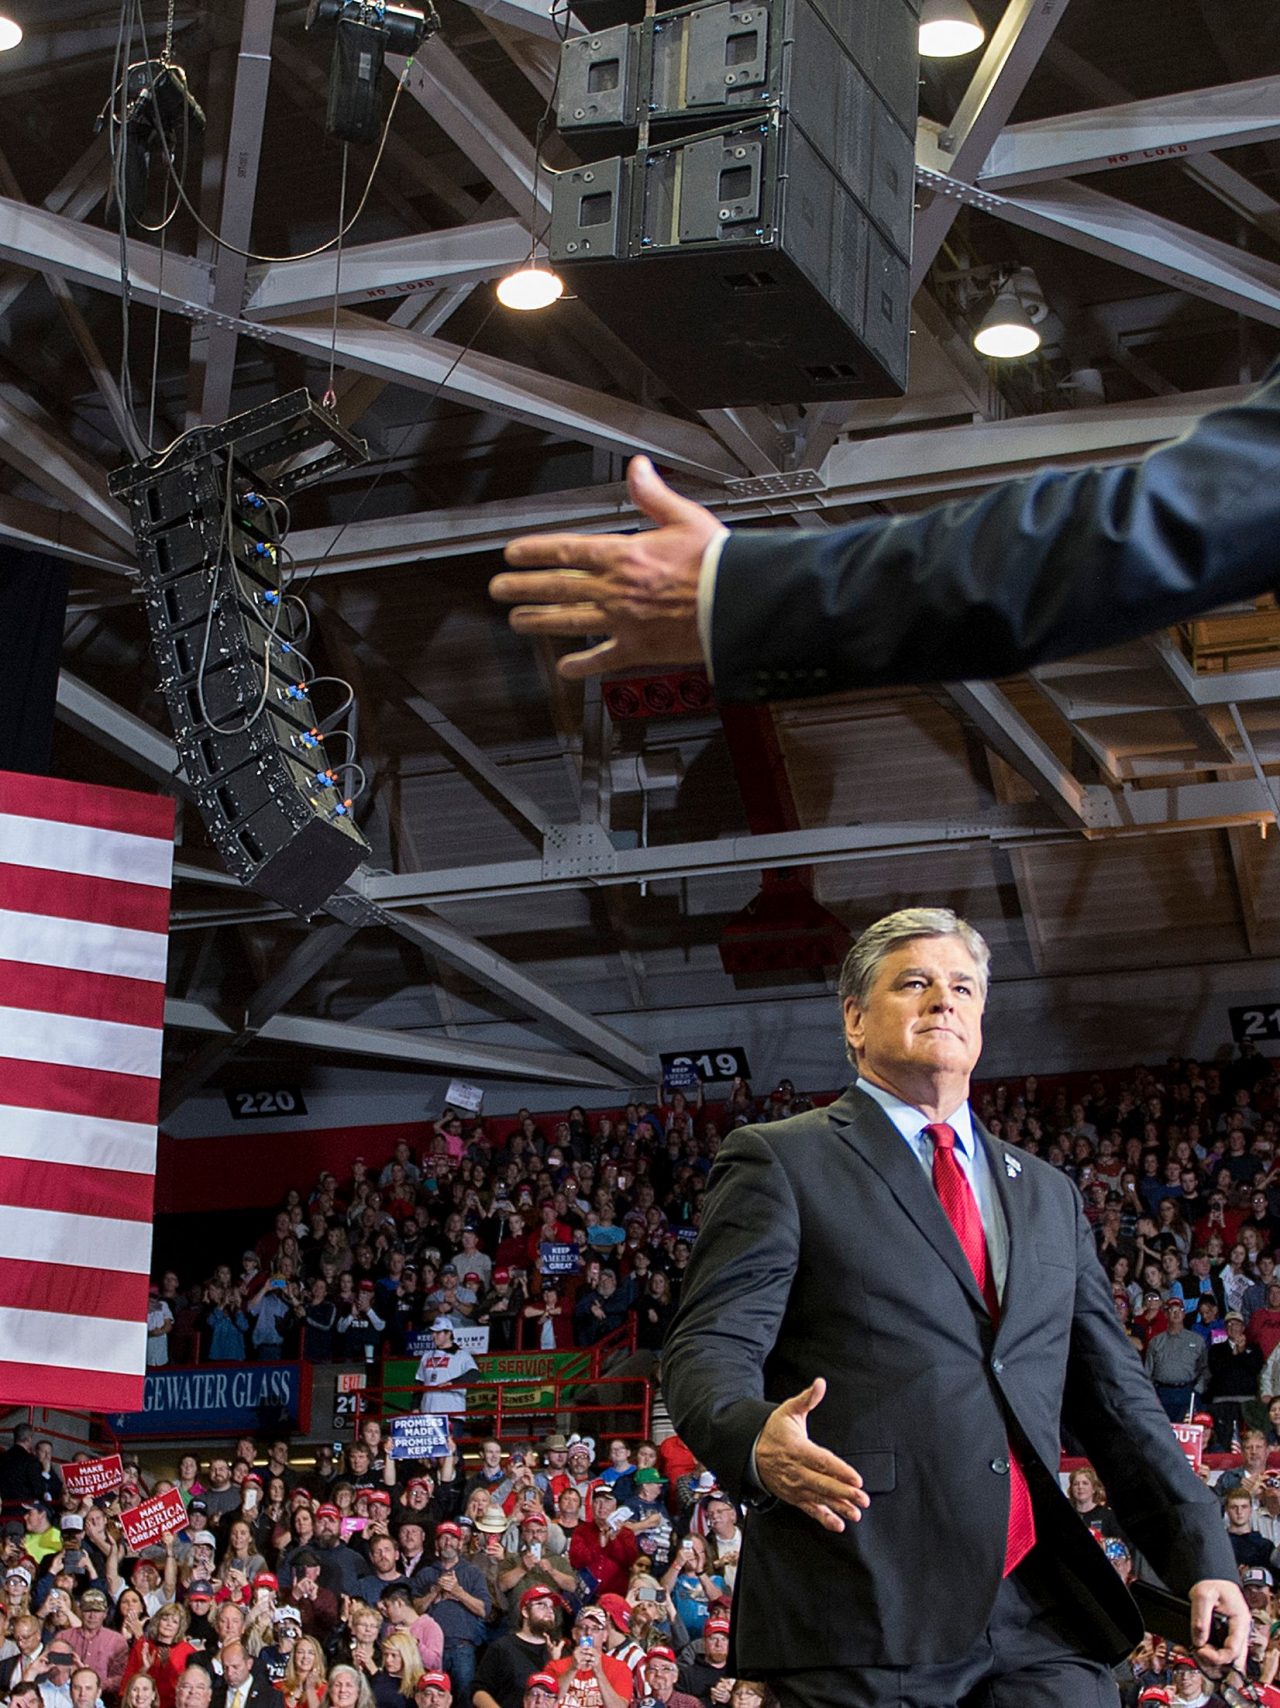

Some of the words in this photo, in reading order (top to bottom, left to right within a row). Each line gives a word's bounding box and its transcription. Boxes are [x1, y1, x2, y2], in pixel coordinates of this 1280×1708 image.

[1107, 154, 1129, 164] NO
[1142, 144, 1188, 158] LOAD
[366, 289, 386, 298] NO
[396, 280, 434, 292] LOAD
[236, 1090, 295, 1114] 220
[542, 1254, 579, 1263] AMERICA
[549, 1262, 573, 1270] GREAT
[498, 1358, 556, 1379] SERVICE
[143, 1374, 228, 1412] GEWATER
[232, 1370, 291, 1408] GLASS
[491, 1393, 536, 1403] BSINESS
[394, 1417, 443, 1429] PROMISES
[405, 1427, 434, 1436] MADE
[394, 1436, 446, 1447] PROMISES
[407, 1446, 434, 1455] KEPT
[79, 1464, 104, 1474] MAKE
[66, 1468, 122, 1488] AMERICA
[68, 1485, 95, 1495] GREAT
[97, 1476, 122, 1491] AGAIN
[139, 1501, 165, 1518] MAKE
[127, 1503, 184, 1537] AMERICA
[131, 1527, 160, 1545] GREAT
[161, 1514, 186, 1532] AGAIN
